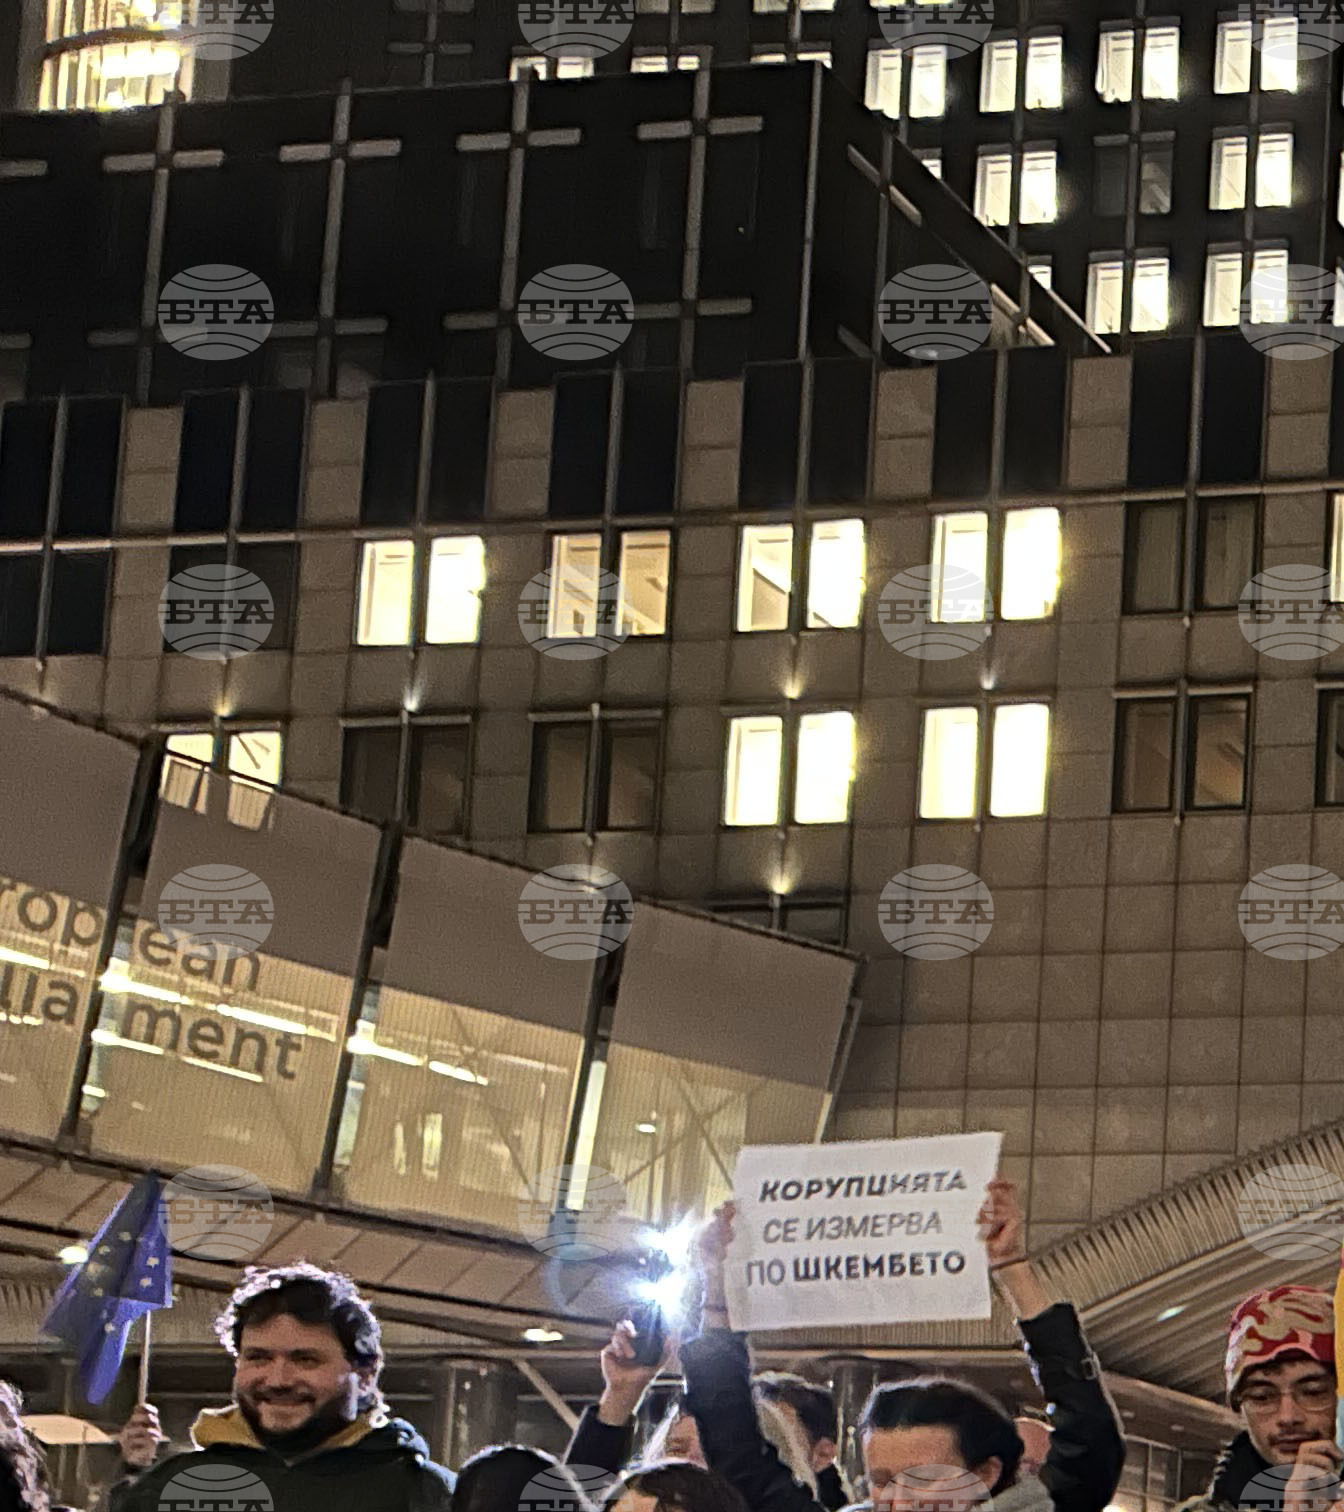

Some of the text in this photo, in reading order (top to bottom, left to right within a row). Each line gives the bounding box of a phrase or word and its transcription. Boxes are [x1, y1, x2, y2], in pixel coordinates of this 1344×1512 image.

[757, 1168, 967, 1203] КОРУПЦИЯТА
[763, 1216, 798, 1244] СЕ
[805, 1211, 943, 1241] ИЗМЕРВА
[745, 1251, 966, 1287] ПО ШКЕМБЕТО
